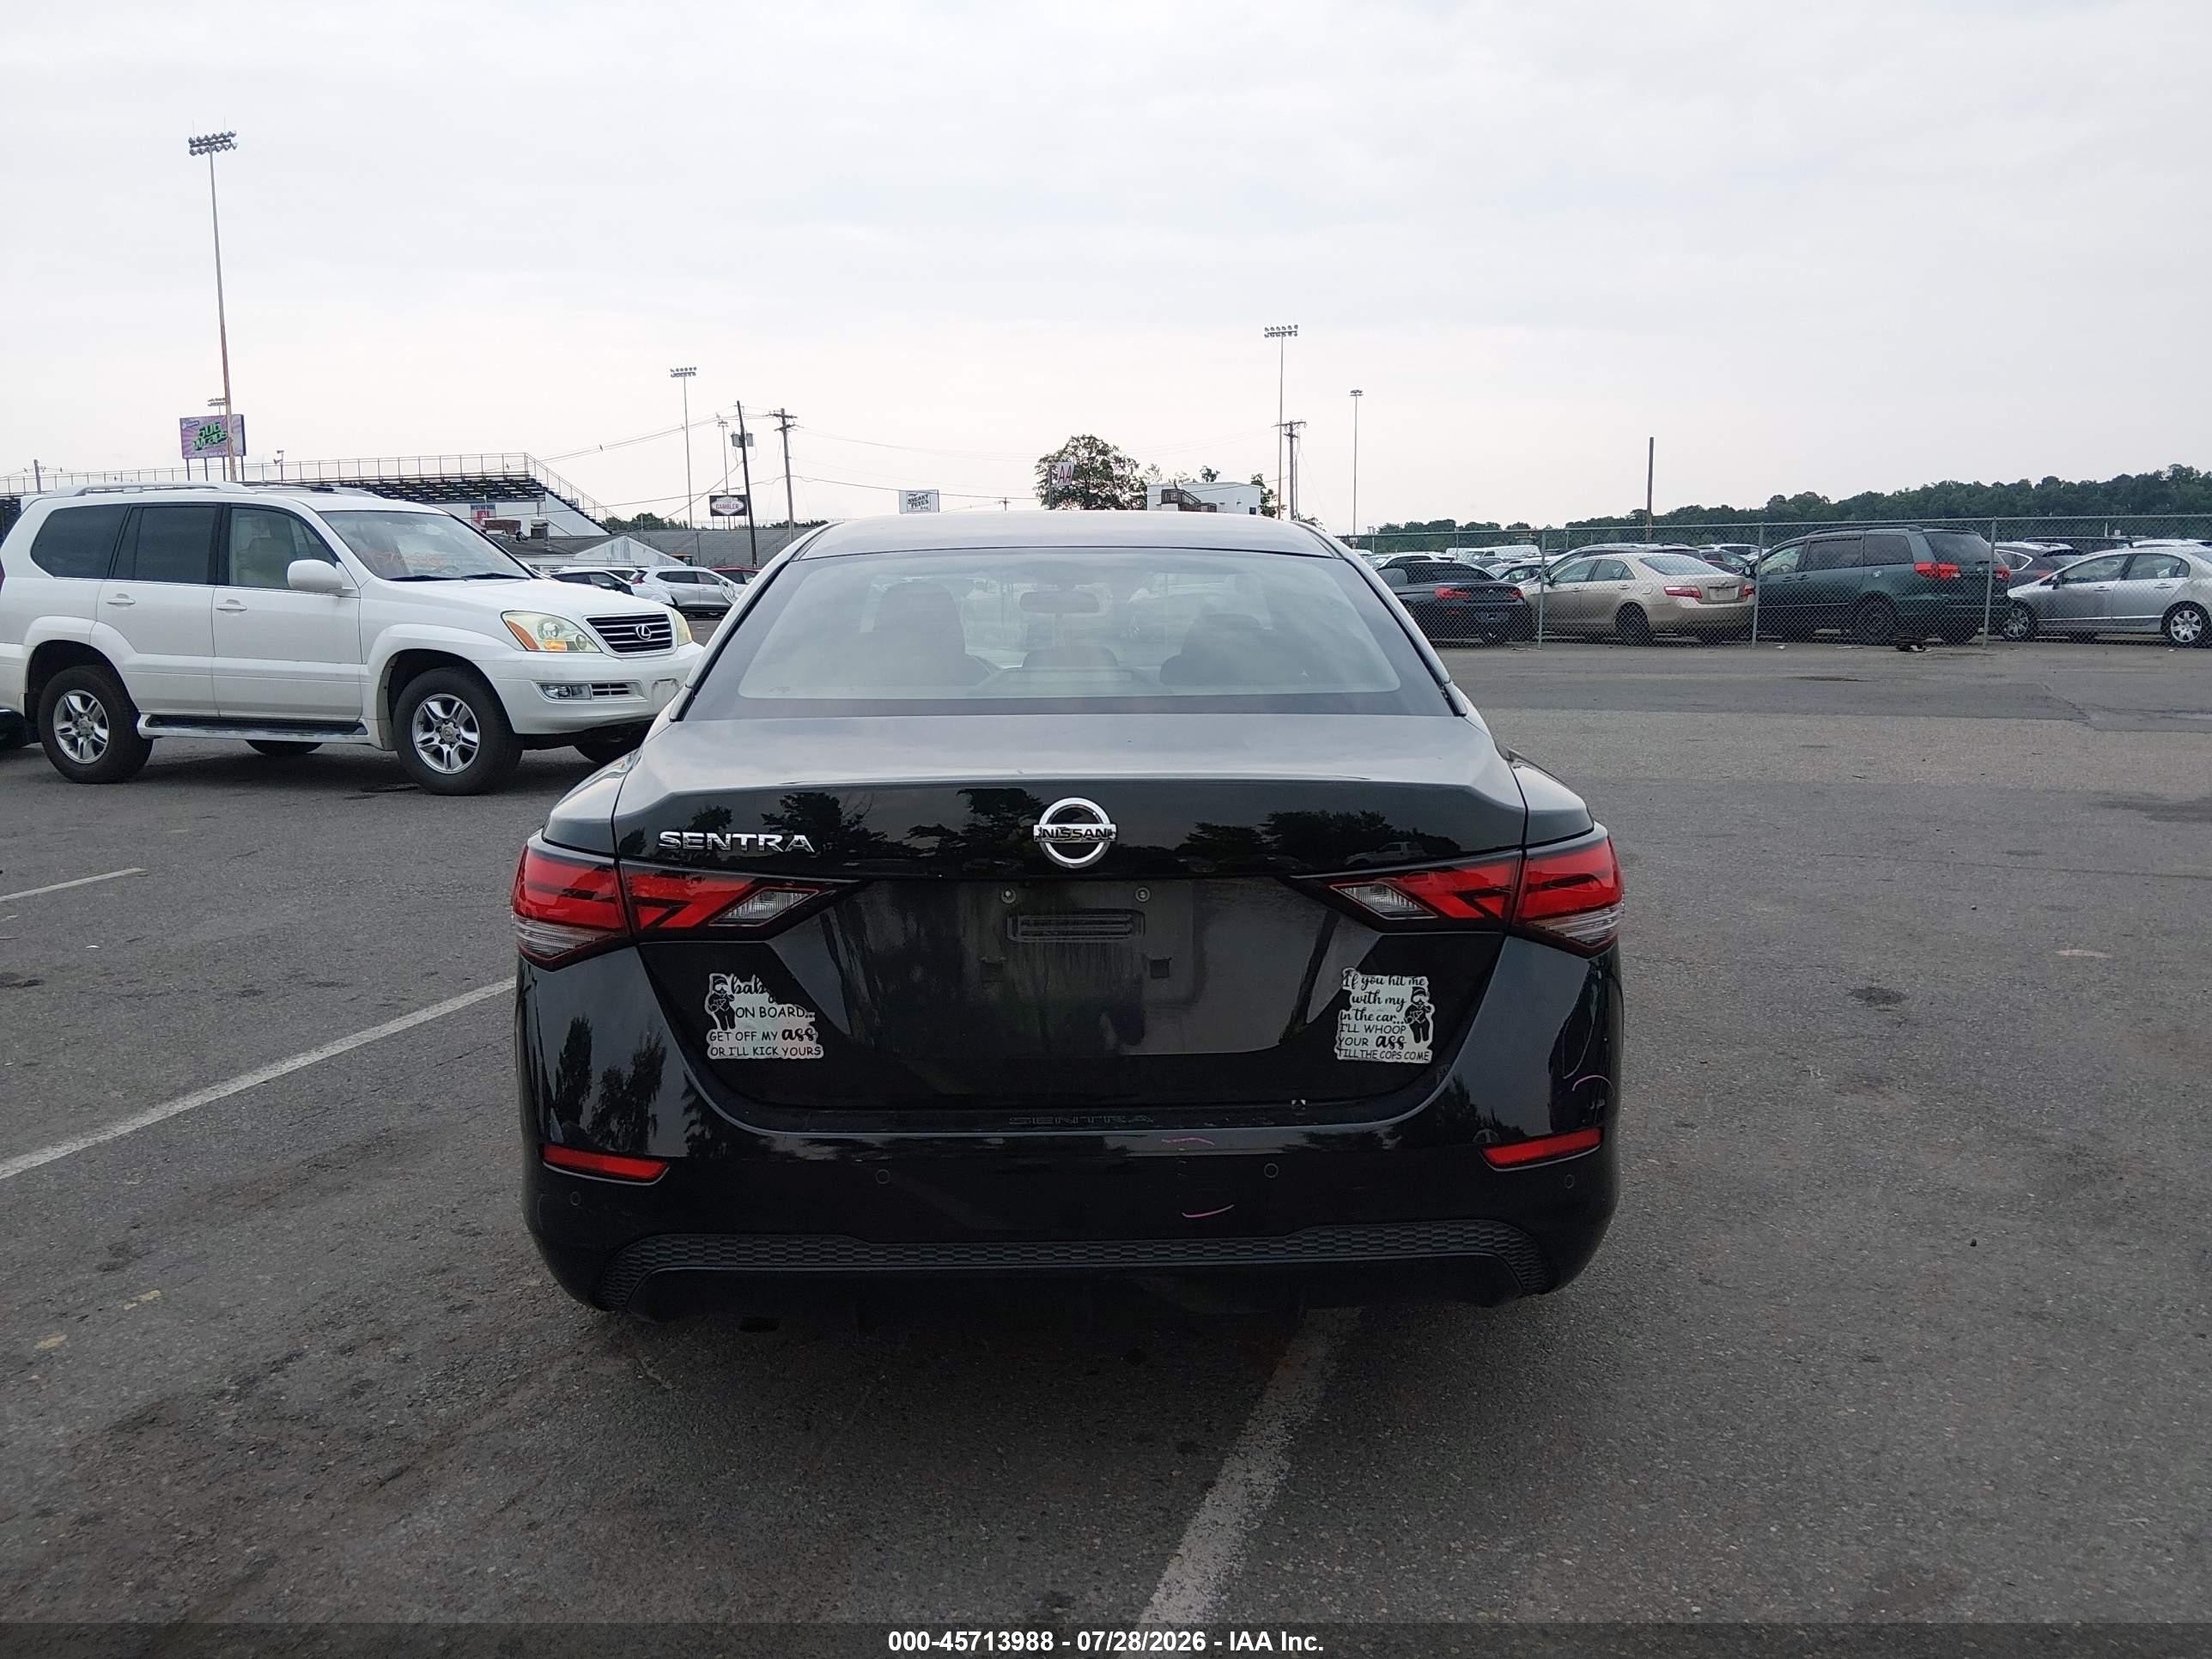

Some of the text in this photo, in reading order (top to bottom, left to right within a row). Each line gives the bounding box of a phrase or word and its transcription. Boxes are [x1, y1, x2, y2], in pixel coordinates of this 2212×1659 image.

[1058, 465, 1073, 484] AA
[1042, 828, 1107, 839] NISSAN
[658, 830, 815, 854] SENTRA
[1342, 969, 1425, 990] If you hit me
[1352, 990, 1407, 1012] with my
[735, 1006, 756, 1018] ON
[1355, 1007, 1374, 1022] the
[709, 1028, 817, 1042] GET OFF MY ass
[1364, 1024, 1407, 1035] WHOOP
[1338, 1036, 1407, 1049] YOUR ass
[710, 1047, 726, 1057] OR
[752, 1046, 779, 1056] KICK
[781, 1046, 822, 1057] YOURS
[1337, 1048, 1430, 1061] TILL THE COPS COME
[1009, 1115, 1155, 1126] SENTRA
